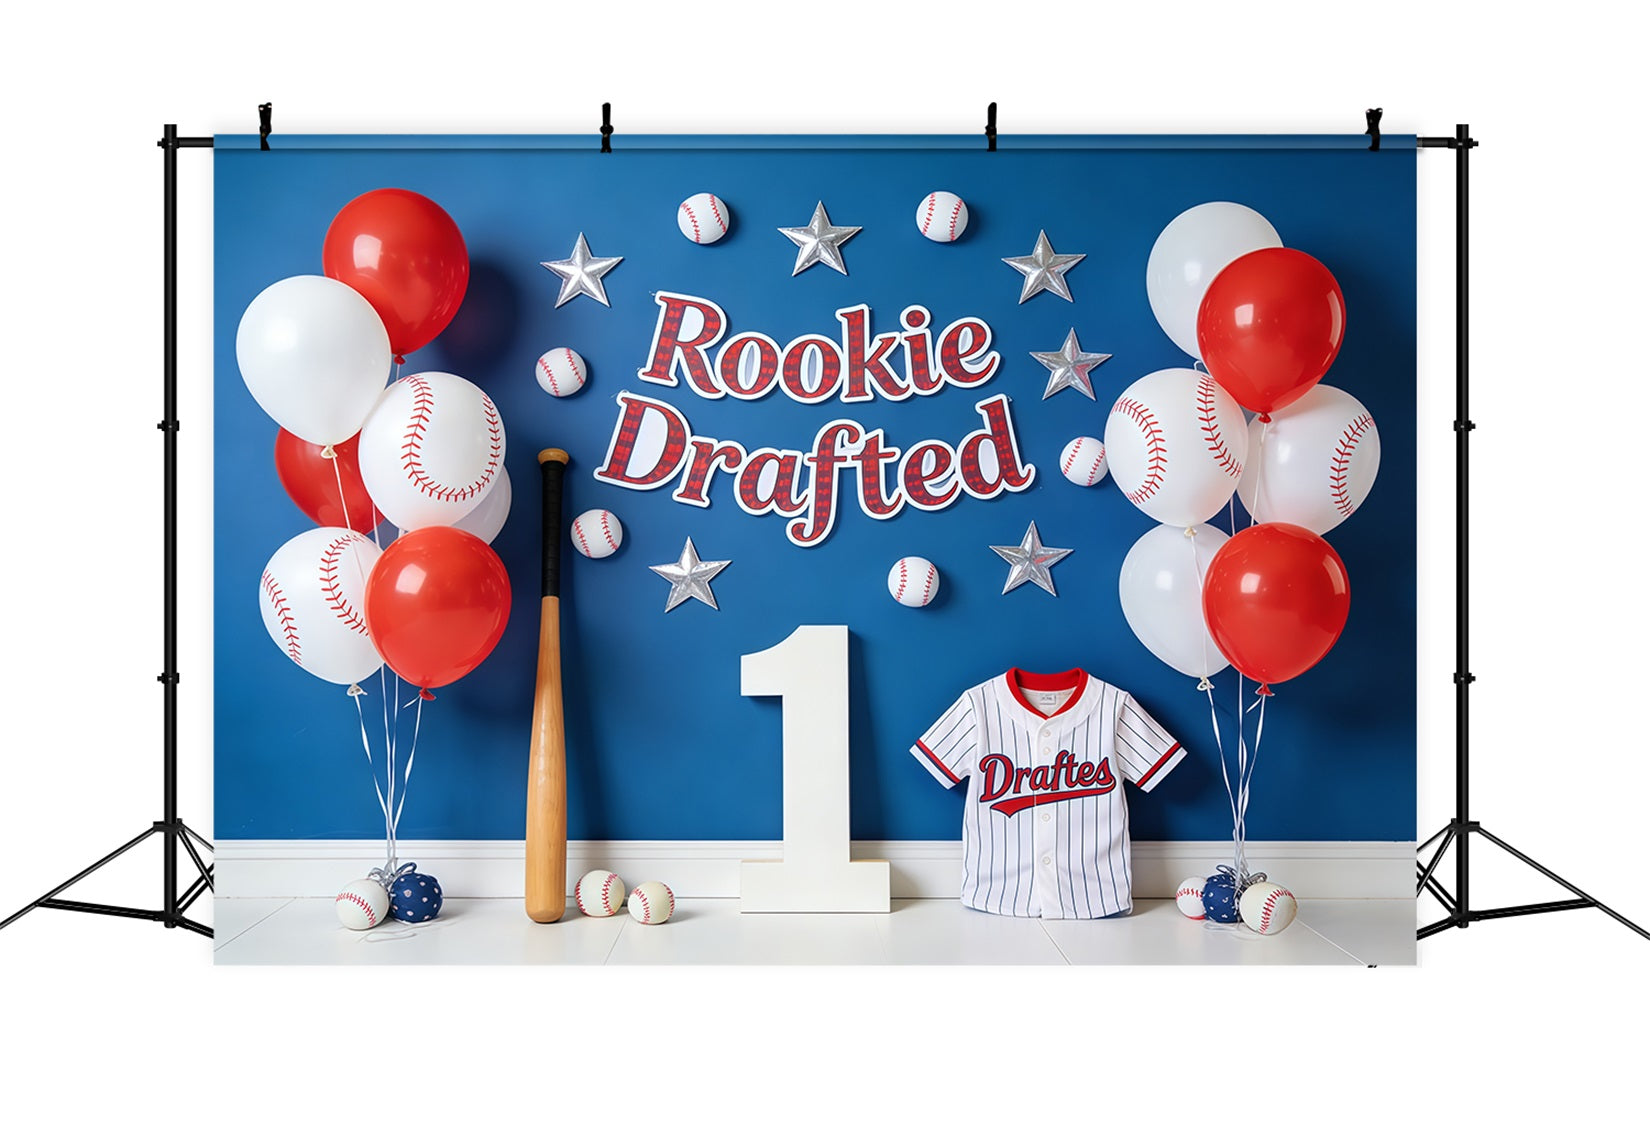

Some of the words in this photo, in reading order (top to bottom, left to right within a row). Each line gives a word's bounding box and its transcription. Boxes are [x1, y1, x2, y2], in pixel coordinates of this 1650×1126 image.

[639, 292, 999, 402] Rookie
[595, 391, 1035, 546] Drafted
[741, 625, 890, 913] 1
[979, 750, 1116, 803] Draftes
